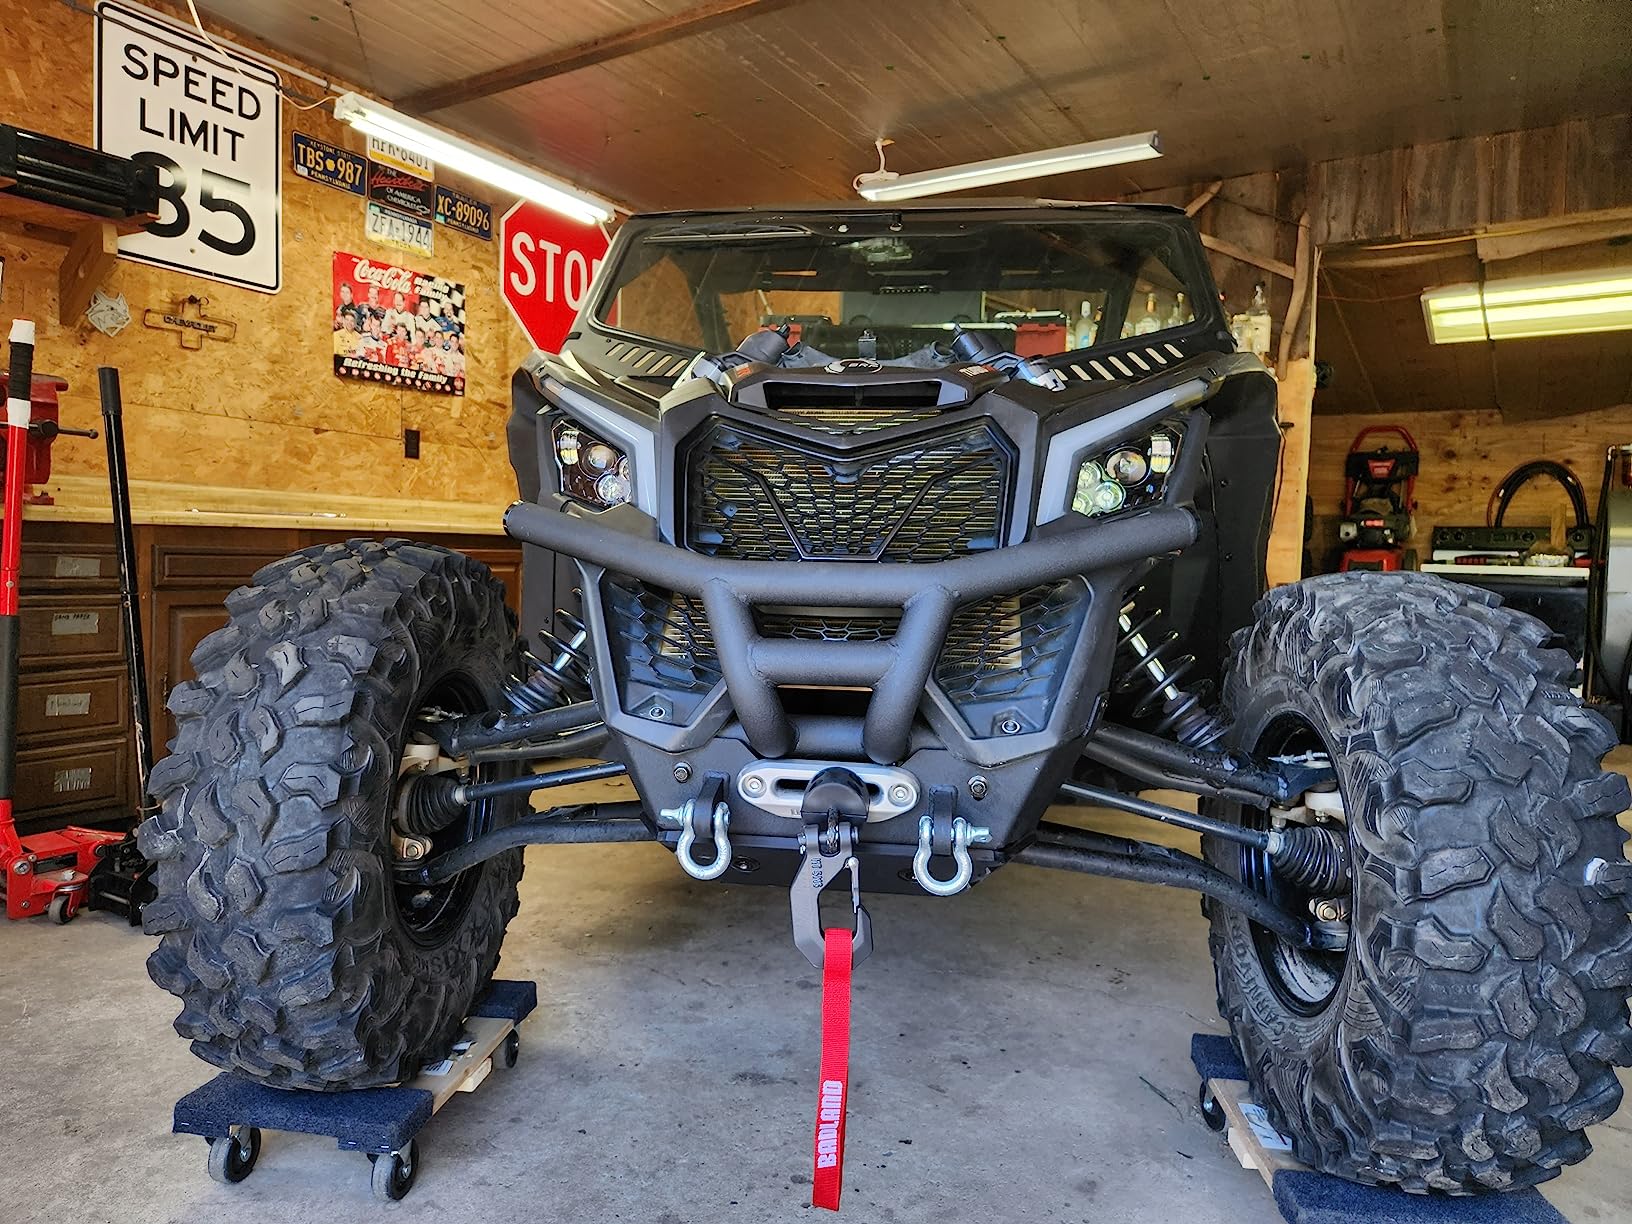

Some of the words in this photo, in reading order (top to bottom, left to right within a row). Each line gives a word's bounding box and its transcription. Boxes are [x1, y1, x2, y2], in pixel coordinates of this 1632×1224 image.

[121, 43, 261, 120] SPEED
[140, 97, 245, 161] LIMIT
[343, 357, 399, 377] Refreshing
[400, 367, 417, 379] the
[418, 371, 448, 385] Family
[817, 1079, 844, 1169] BADLAND
